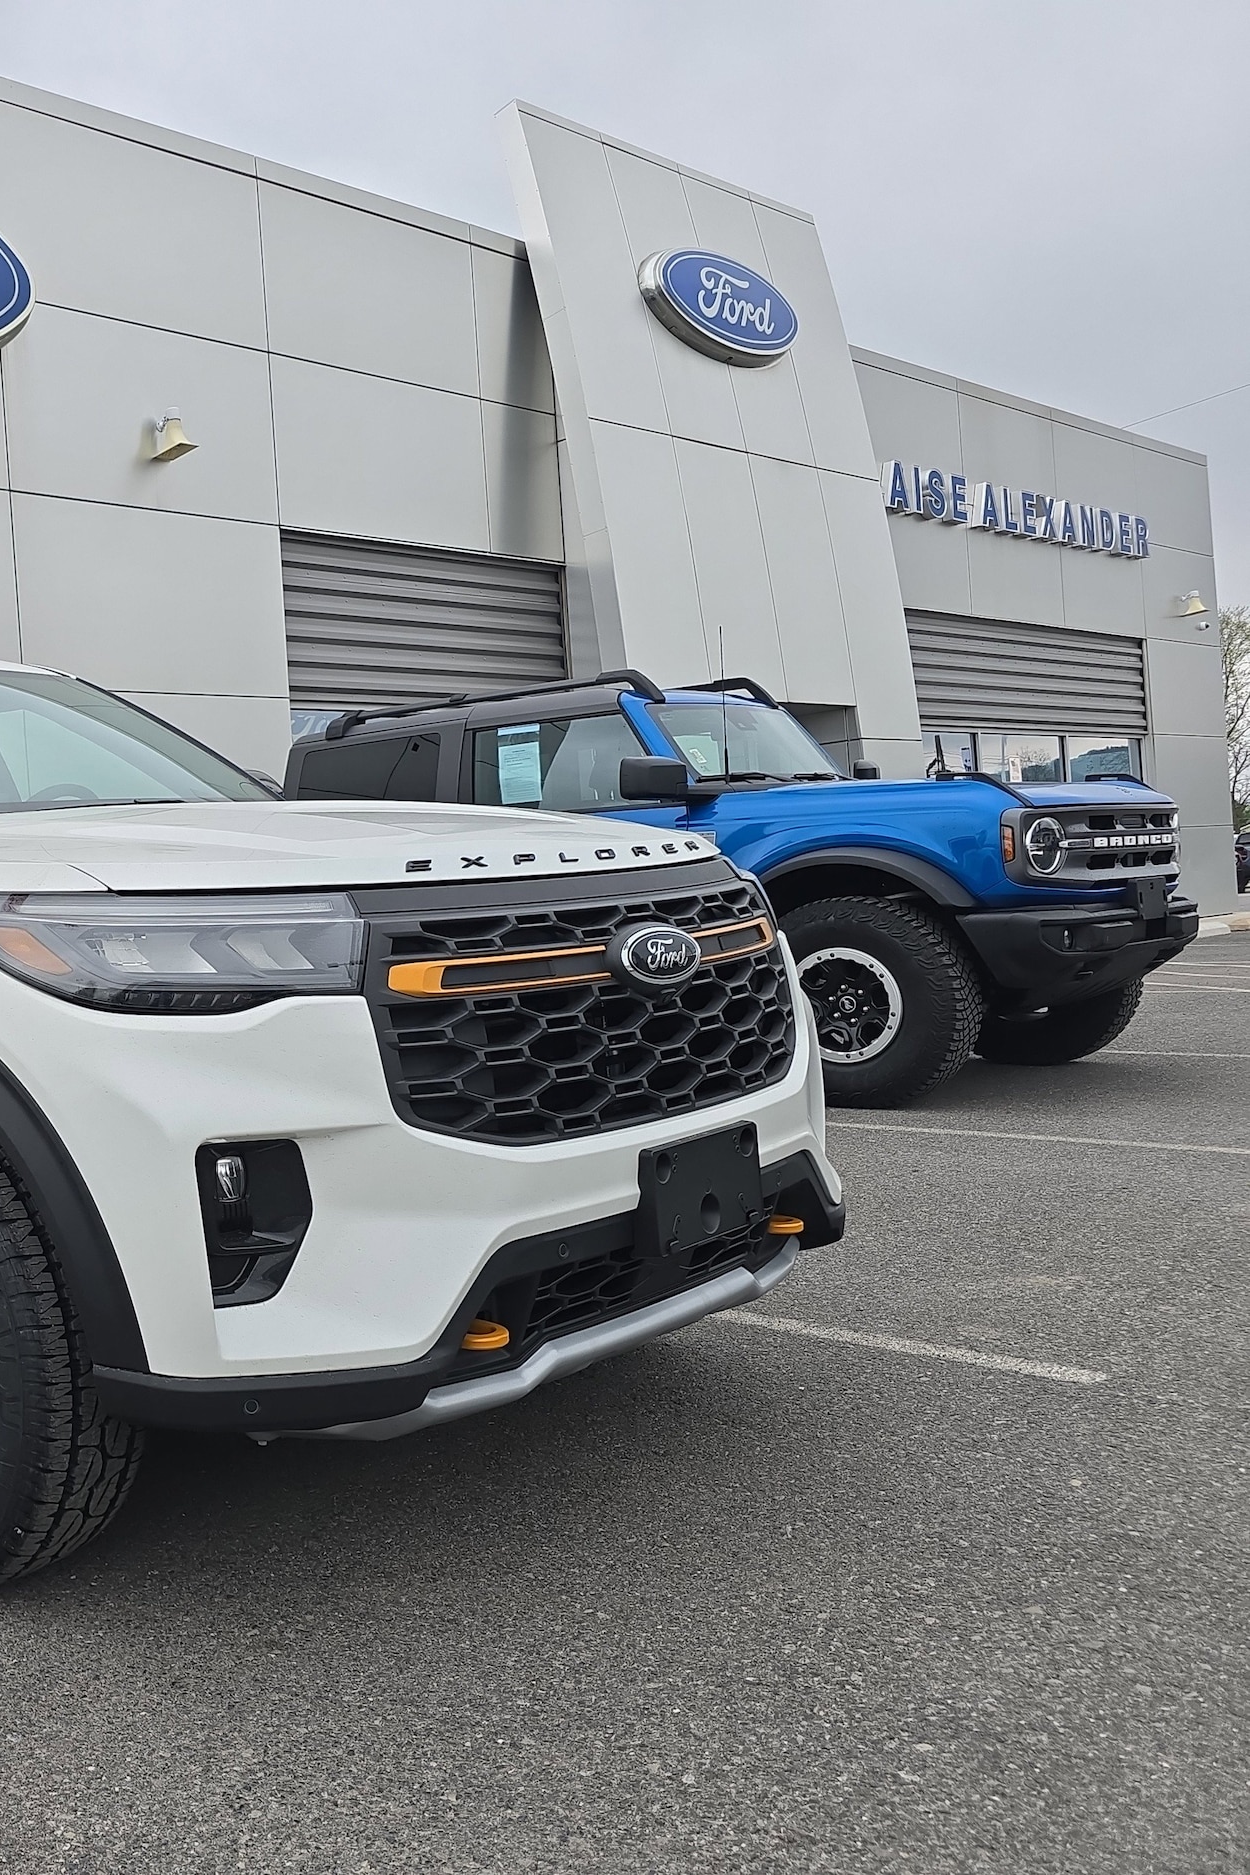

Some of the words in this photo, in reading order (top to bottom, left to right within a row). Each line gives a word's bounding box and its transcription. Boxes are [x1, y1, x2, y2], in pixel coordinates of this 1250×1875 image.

[697, 266, 775, 336] Ford
[883, 459, 969, 523] AISE
[976, 481, 1150, 559] ALEXANDER
[405, 840, 701, 873] EXPLORER
[1093, 834, 1173, 848] BRONCO
[646, 938, 689, 971] Ford
